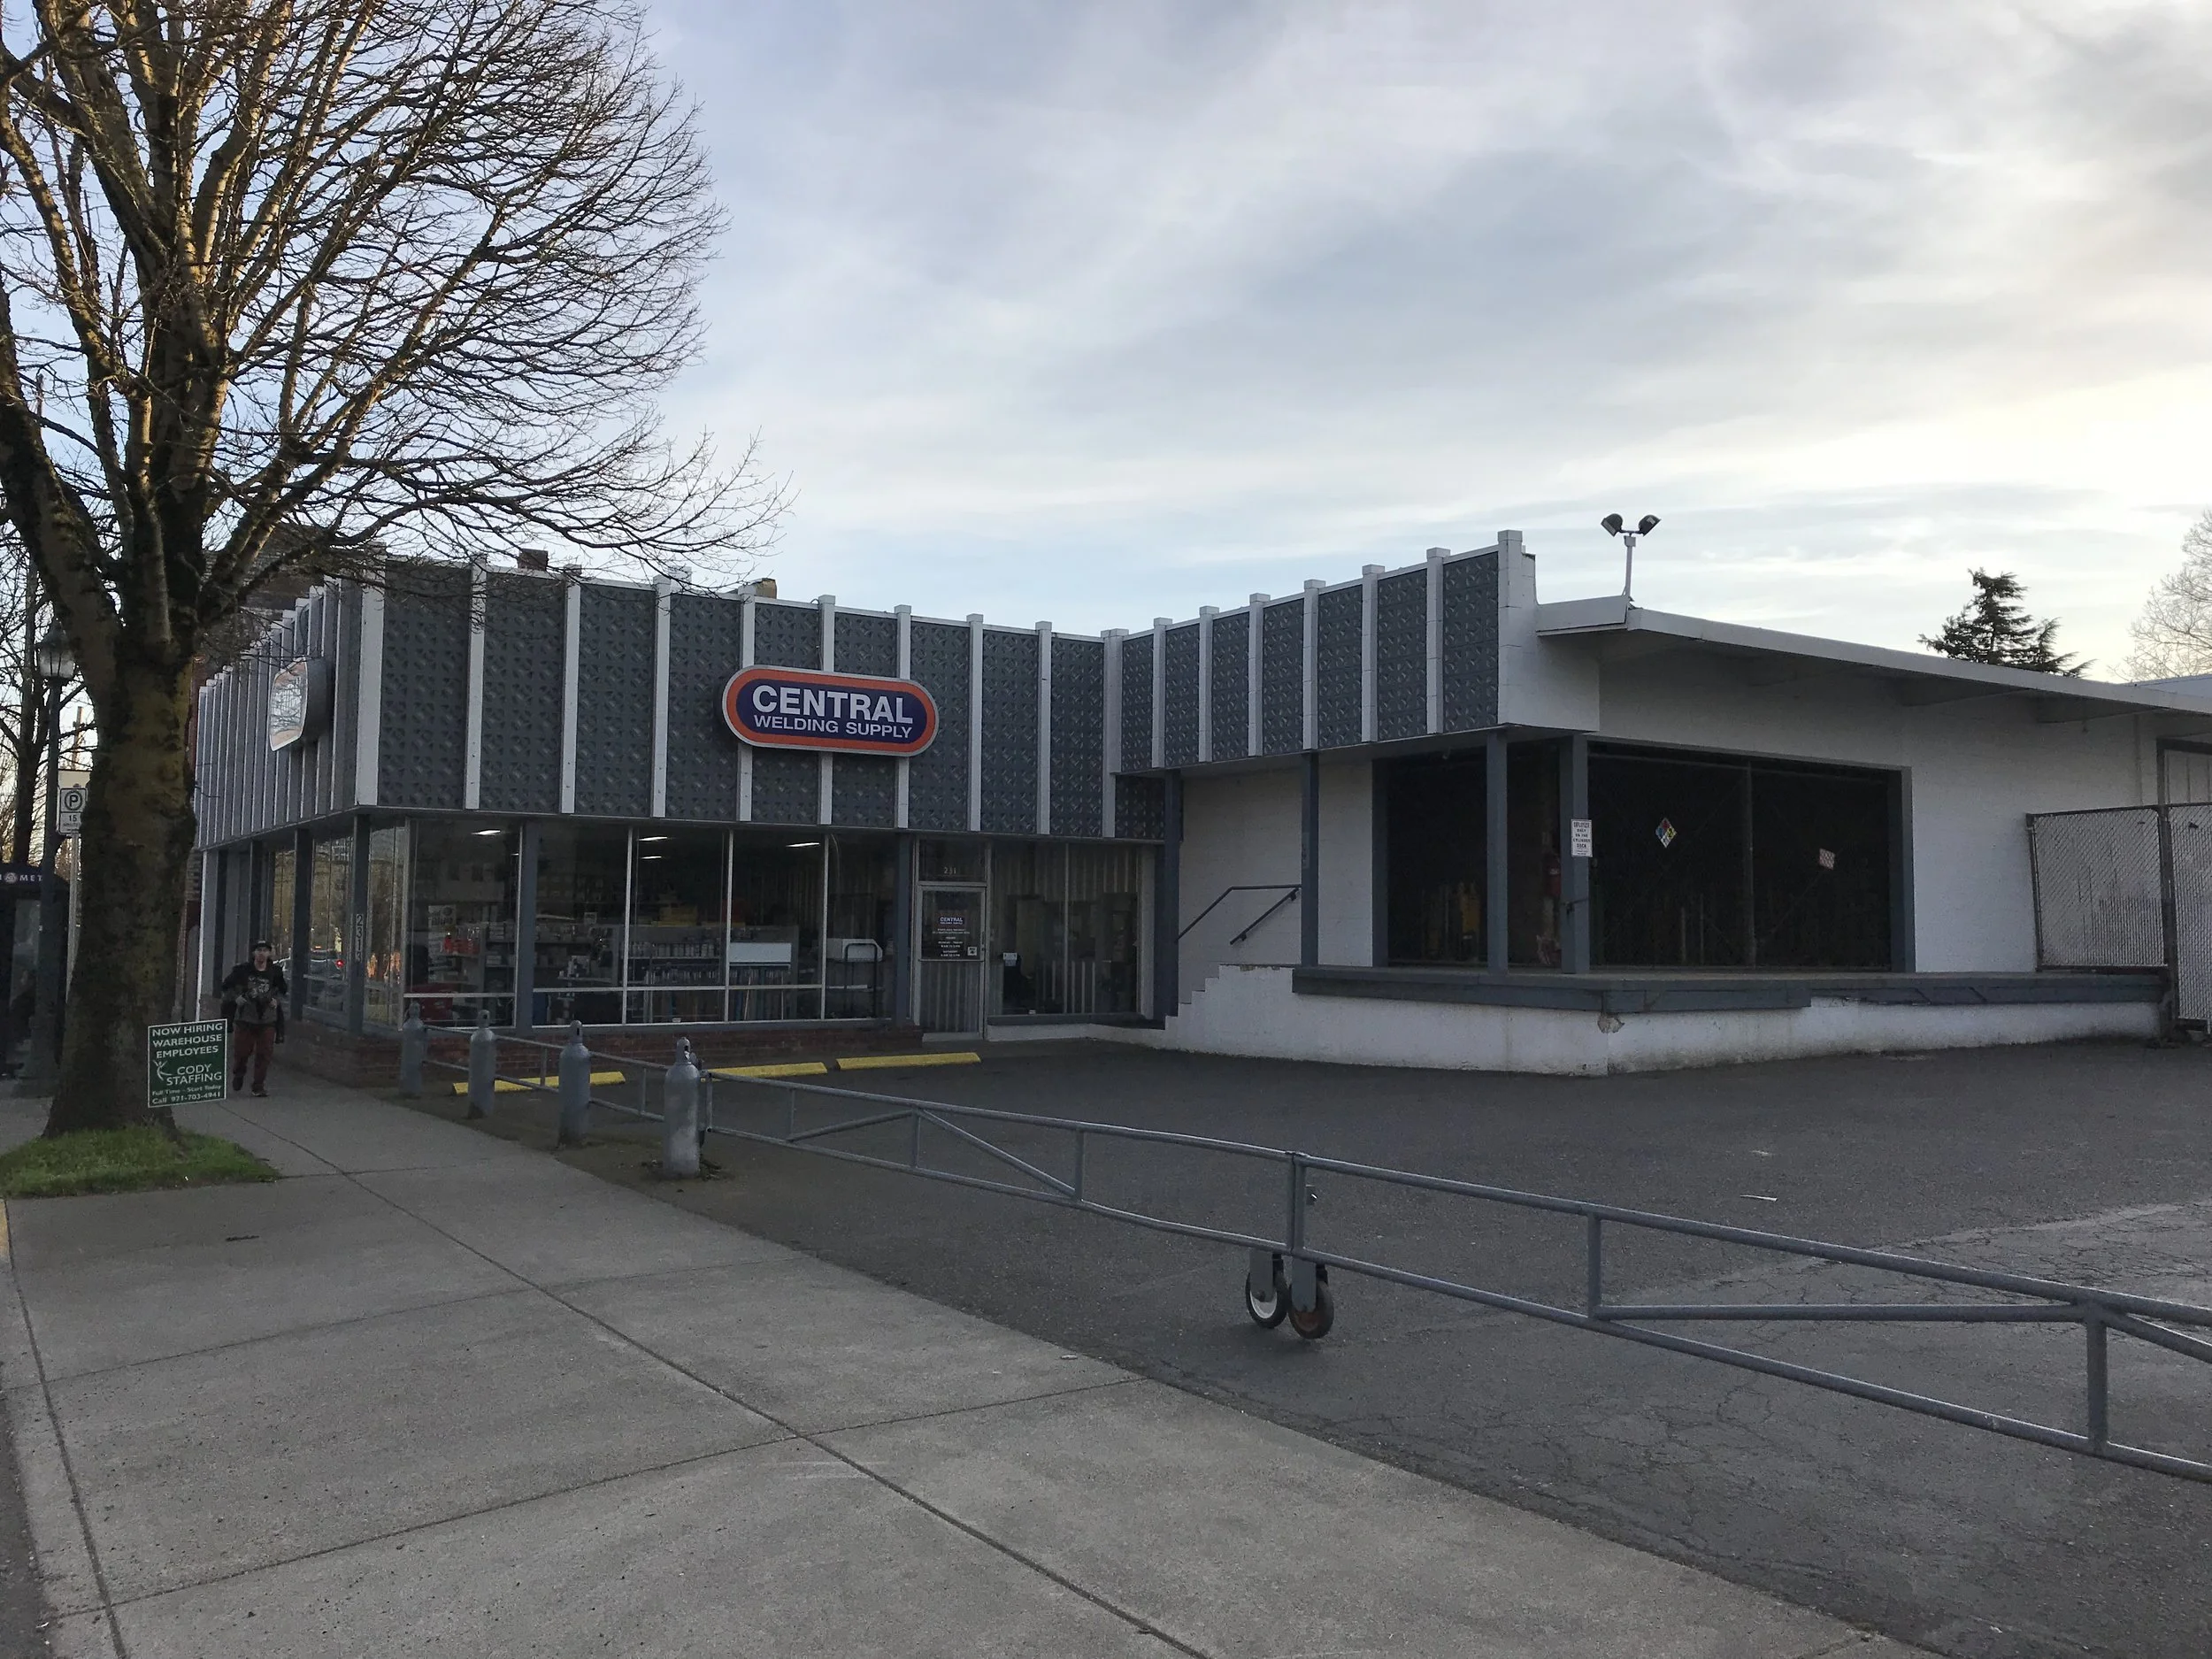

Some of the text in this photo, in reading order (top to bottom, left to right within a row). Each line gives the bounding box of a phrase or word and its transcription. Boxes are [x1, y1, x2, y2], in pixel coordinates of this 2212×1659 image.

[752, 685, 913, 725] CENTRAL
[754, 714, 913, 739] WELDING SUPPLY
[152, 1023, 223, 1037] NOW HIRING
[152, 1033, 222, 1048] WAREHOUSE
[156, 1045, 219, 1059] EMPLOYEES
[177, 1064, 212, 1075] CODY
[166, 1071, 222, 1086] STAFFING
[171, 1091, 220, 1102] 971-703-4941
